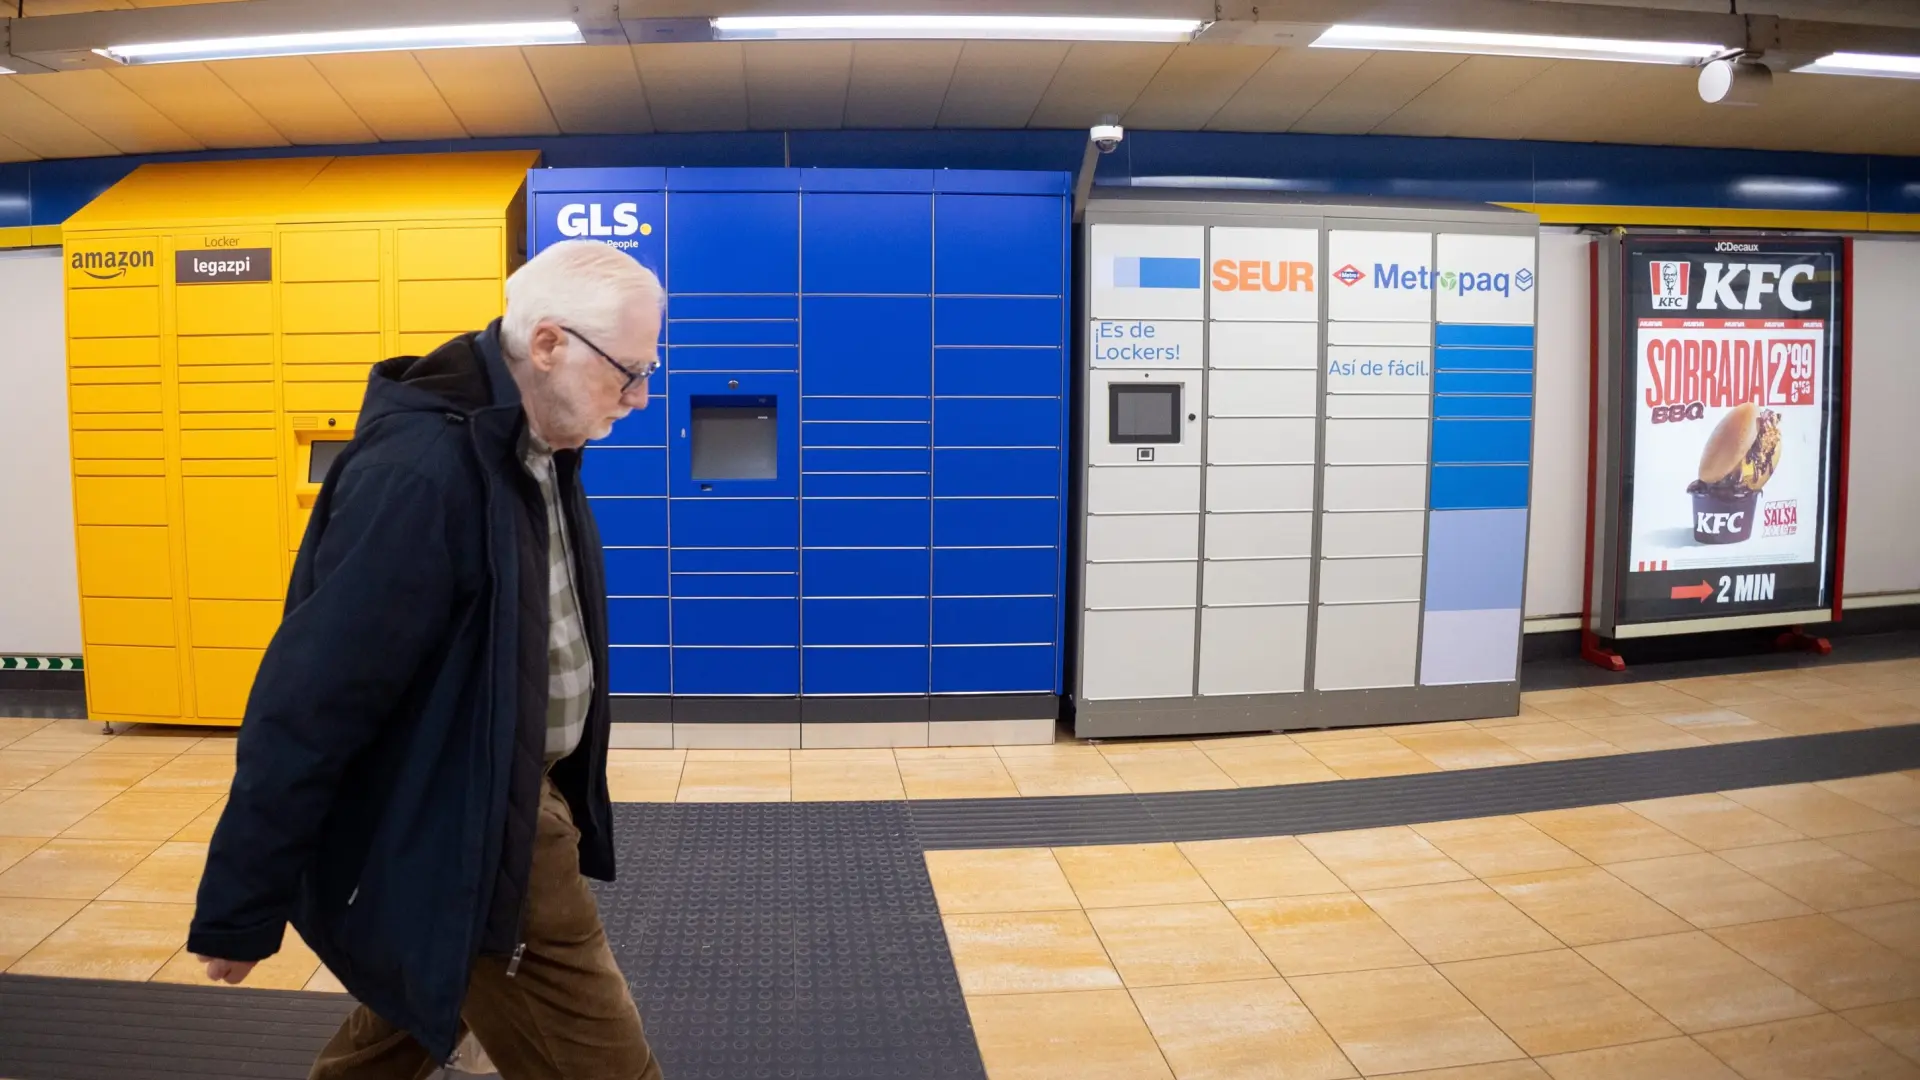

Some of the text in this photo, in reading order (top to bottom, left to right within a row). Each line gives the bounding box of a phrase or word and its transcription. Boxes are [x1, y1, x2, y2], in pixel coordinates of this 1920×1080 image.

[204, 236, 240, 248] Locker
[607, 239, 639, 250] People
[1715, 242, 1759, 252] JCDecaux
[71, 250, 154, 269] amazon
[193, 256, 250, 276] legazpi
[1211, 259, 1314, 292] SEUR
[1696, 262, 1815, 311] KFC
[1658, 297, 1682, 307] KFC
[1095, 321, 1155, 343] ¡Es de
[1095, 343, 1180, 360] Lockers!
[1329, 359, 1429, 376] Así de fácil.
[1645, 339, 1765, 408] SOBRADA
[1651, 402, 1704, 424] BBQ
[1696, 511, 1744, 534] KFC
[1764, 506, 1797, 526] SALSA
[1716, 573, 1776, 603] 2 MIN
